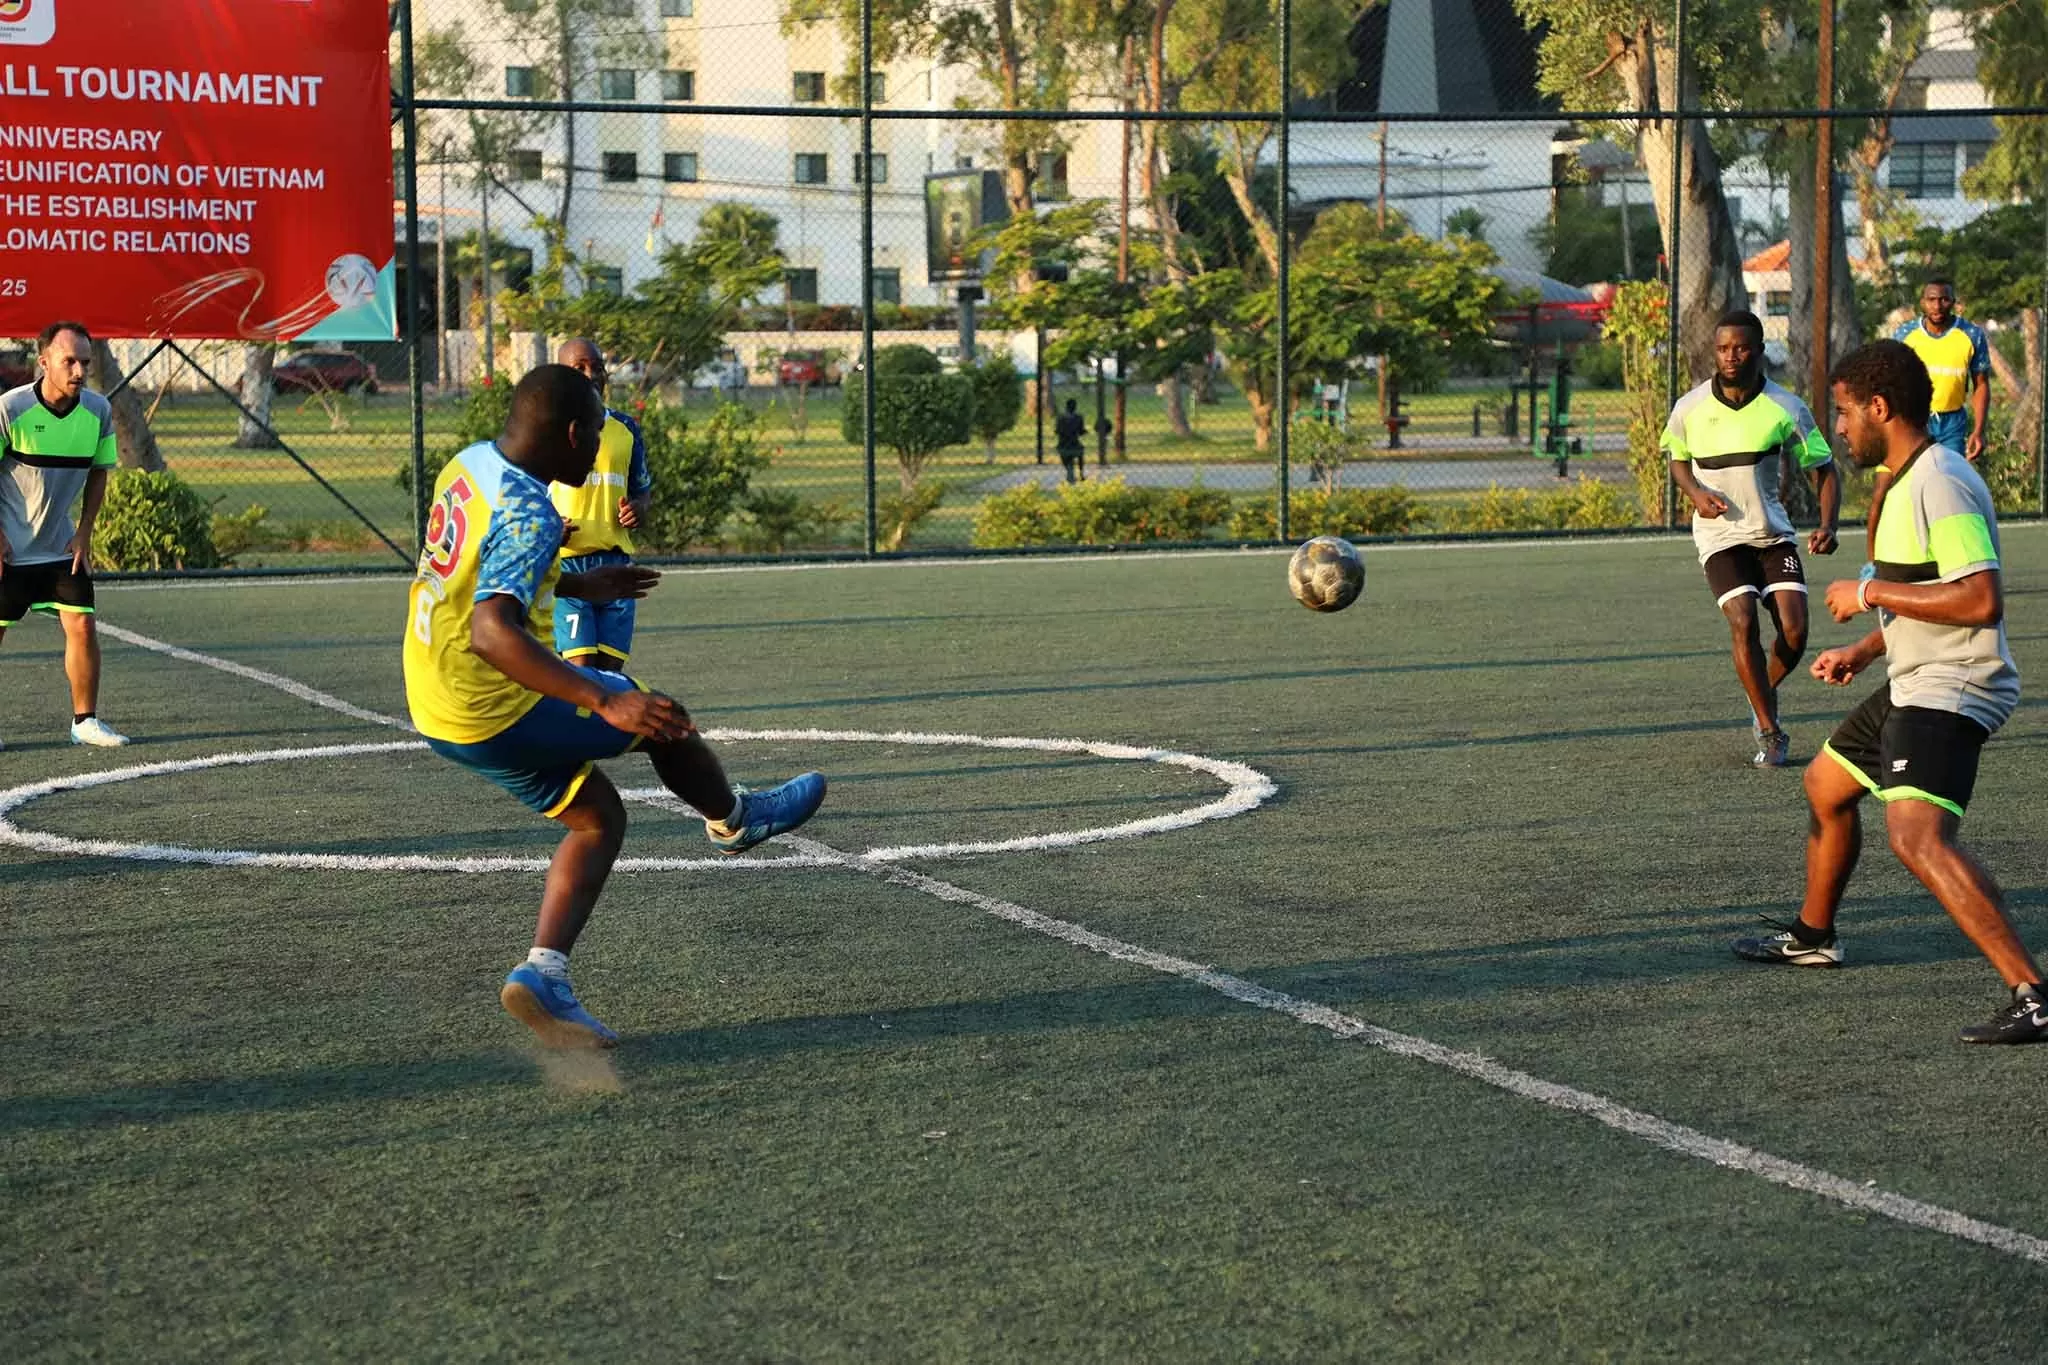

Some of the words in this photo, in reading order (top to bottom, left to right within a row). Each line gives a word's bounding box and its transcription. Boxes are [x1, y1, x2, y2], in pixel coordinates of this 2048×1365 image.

[0, 64, 49, 96] LL
[56, 66, 323, 107] TOURNAMENT
[176, 165, 208, 187] OF
[214, 167, 324, 190] VIETNAM
[49, 195, 256, 221] ESTABLISHMENT
[113, 231, 250, 254] RELATIONS
[566, 613, 579, 640] 7
